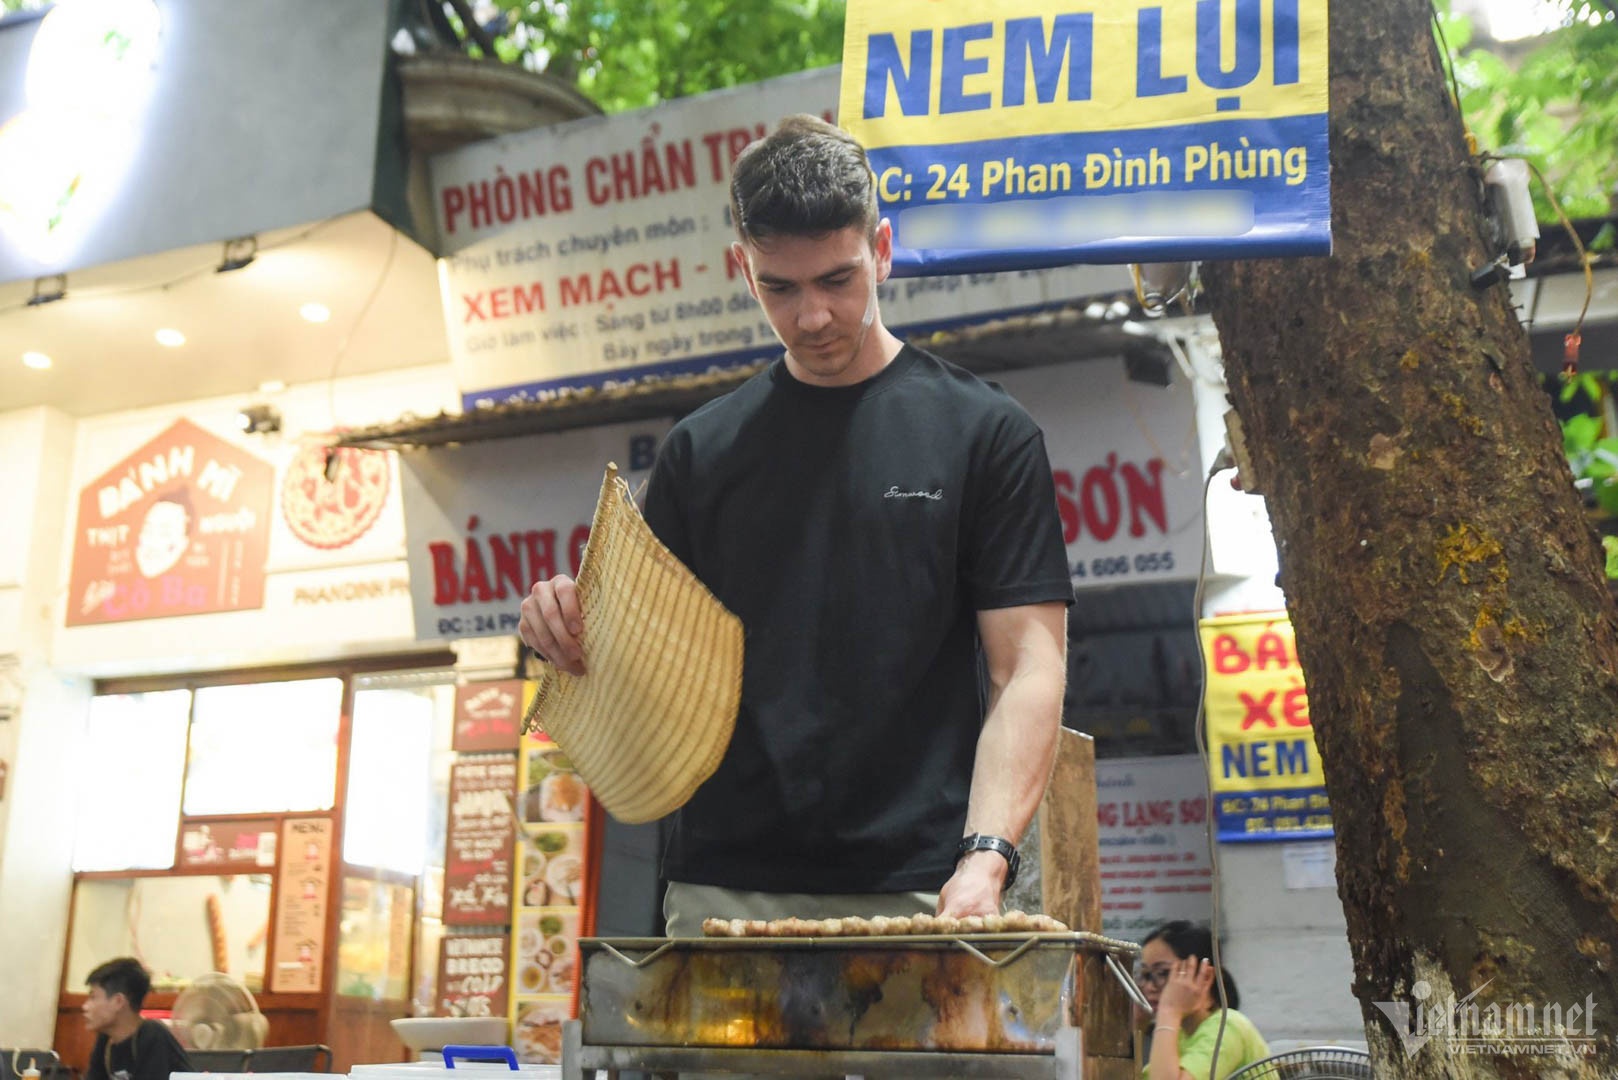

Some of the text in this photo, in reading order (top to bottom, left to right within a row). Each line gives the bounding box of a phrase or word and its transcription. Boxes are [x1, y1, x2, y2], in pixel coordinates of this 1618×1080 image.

[862, 0, 1299, 120] NEM LỤI
[441, 121, 768, 235] PHÒNG CHẨN TR
[926, 162, 970, 199] 24
[982, 156, 1071, 198] Phan
[1083, 147, 1171, 189] Đình
[1185, 136, 1307, 186] Phùng
[496, 241, 553, 268] trách
[557, 223, 640, 257] chuyên
[462, 282, 546, 325] XEM
[559, 256, 682, 312] MẠCH
[596, 310, 647, 334] Sáng
[428, 514, 557, 607] BÁNH
[1212, 620, 1302, 675] BÁ
[1221, 739, 1310, 779] NEM
